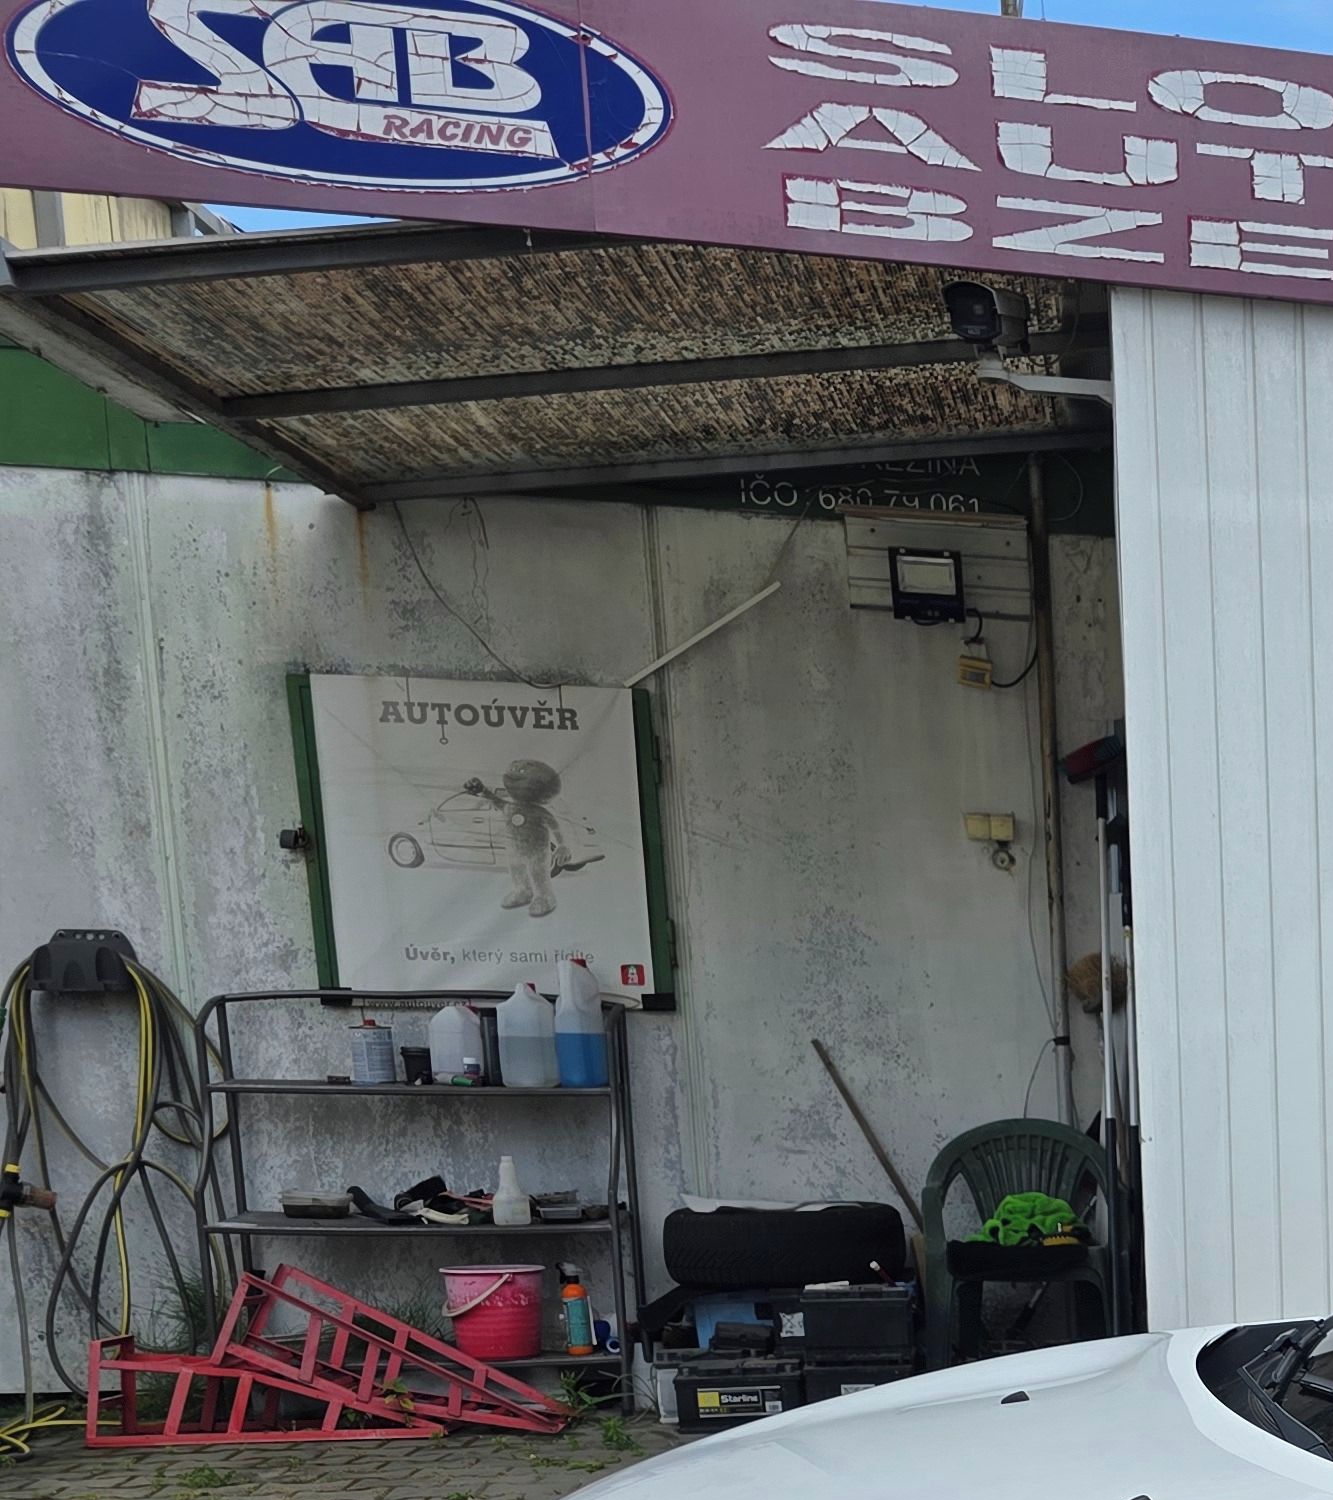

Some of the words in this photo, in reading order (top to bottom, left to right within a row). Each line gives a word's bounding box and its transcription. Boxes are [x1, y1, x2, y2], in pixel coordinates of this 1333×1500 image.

[383, 114, 533, 148] RACING
[379, 698, 580, 730] AUTOÚVĚR
[404, 943, 456, 965] Úvěr,
[462, 948, 503, 965] který
[510, 950, 547, 964] sami
